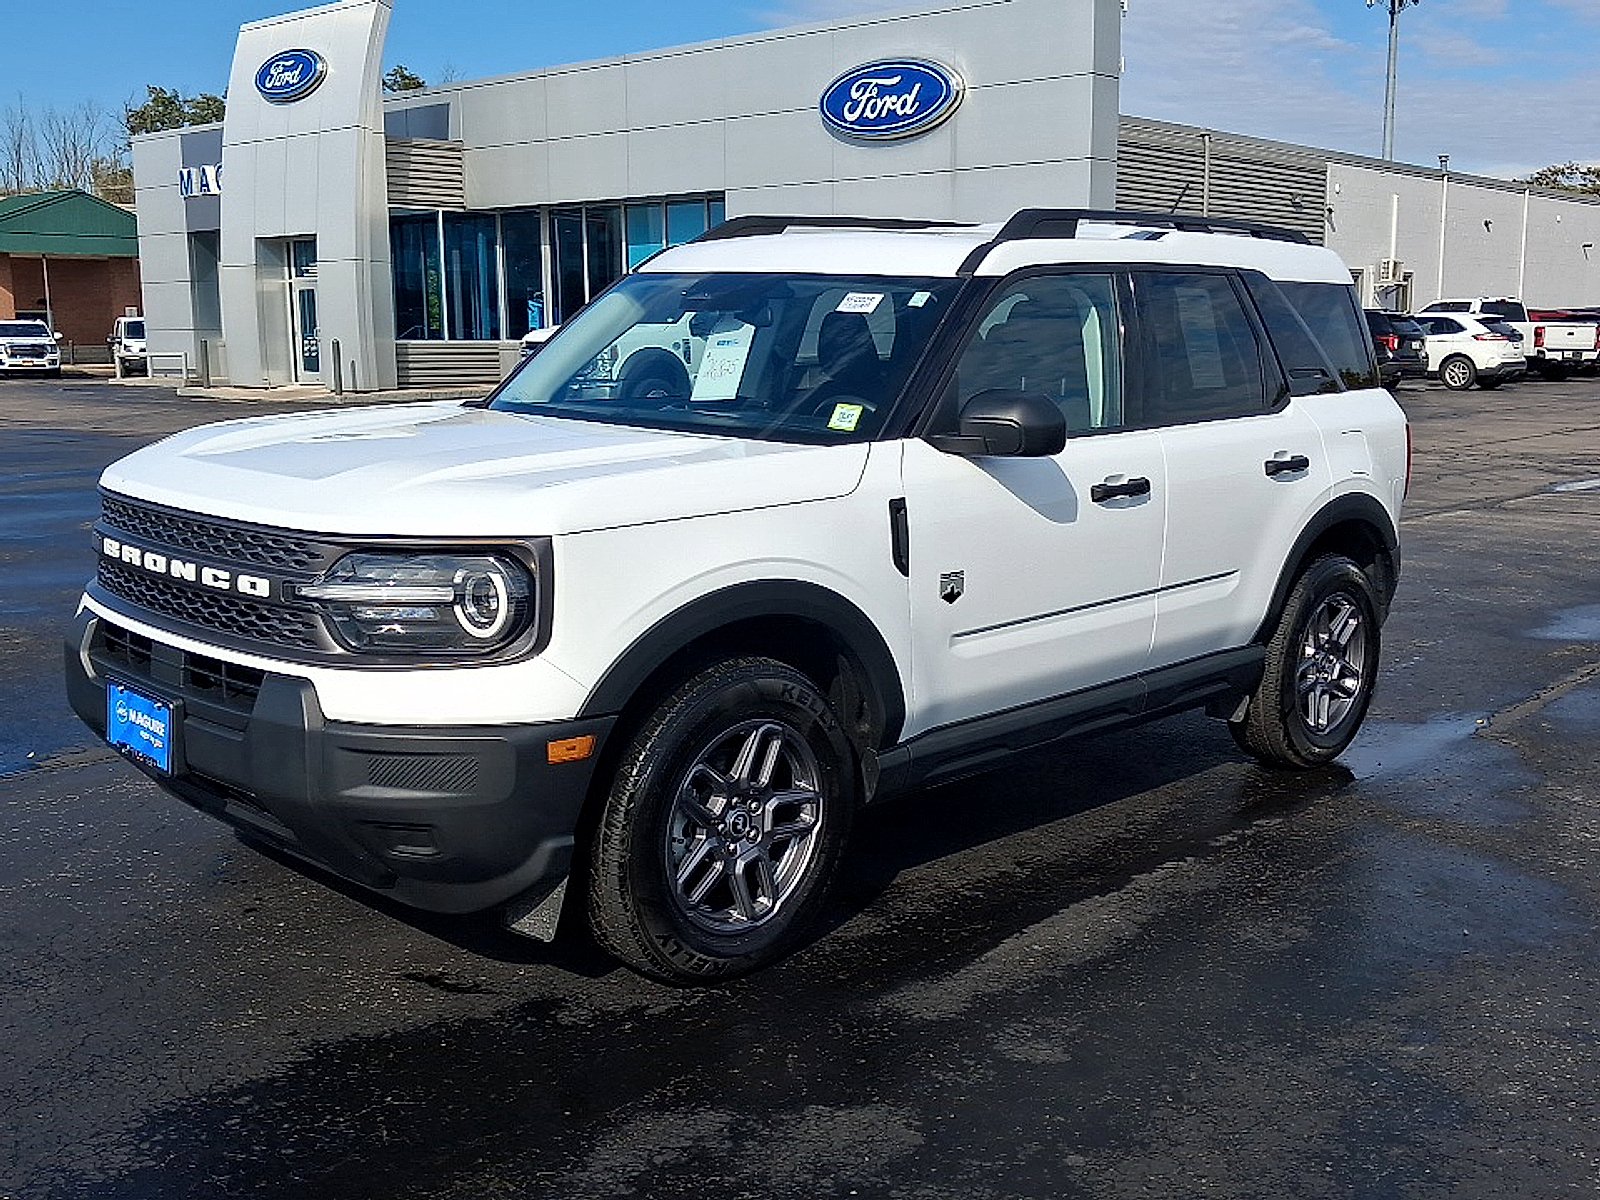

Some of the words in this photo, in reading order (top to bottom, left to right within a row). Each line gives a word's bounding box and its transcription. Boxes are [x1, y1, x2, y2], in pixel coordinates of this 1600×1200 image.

[265, 60, 303, 88] Ford
[843, 75, 921, 121] Ford
[103, 537, 270, 598] BRONCO
[782, 683, 838, 732] KELLY
